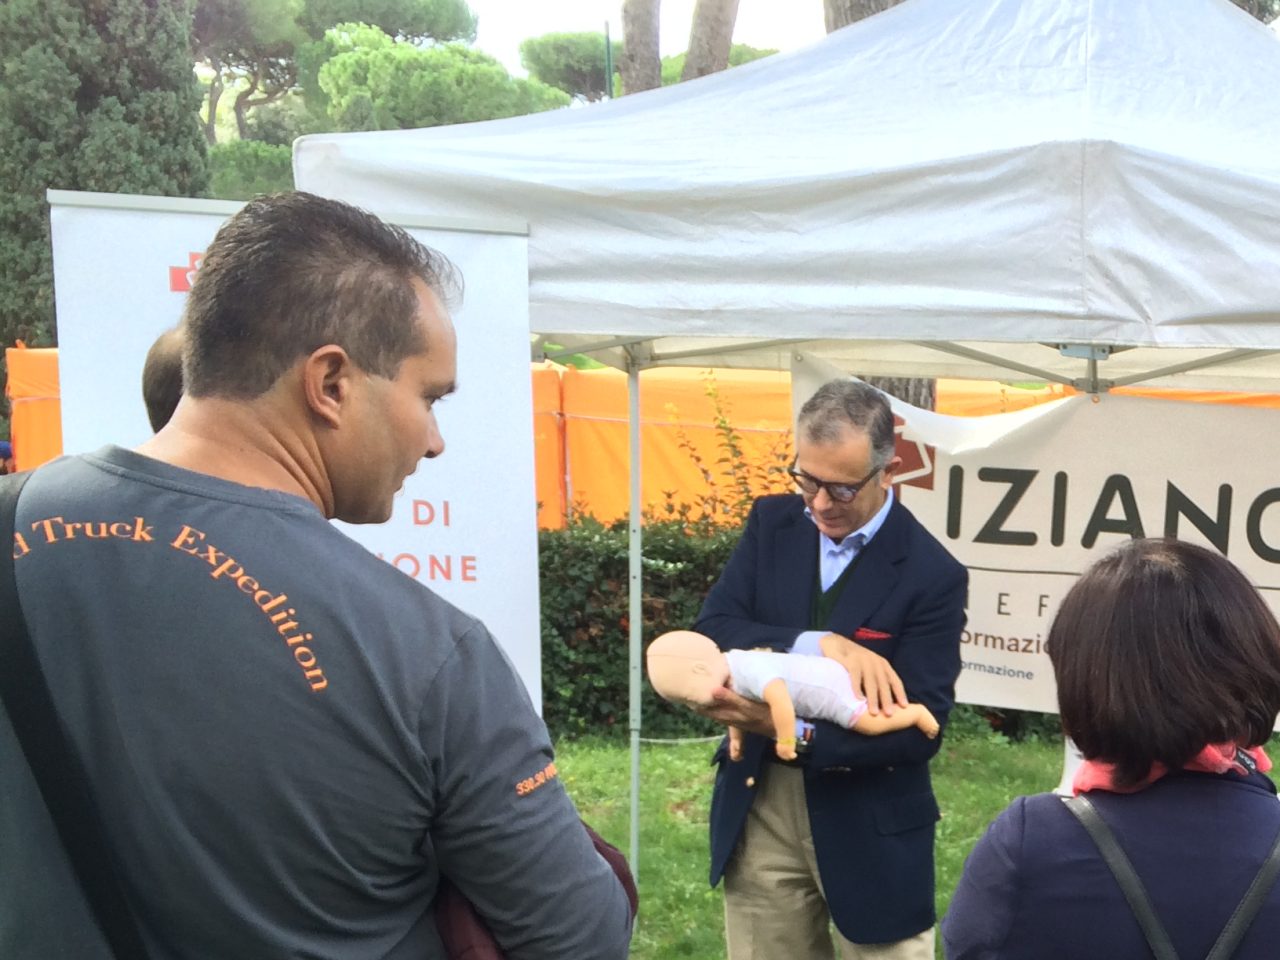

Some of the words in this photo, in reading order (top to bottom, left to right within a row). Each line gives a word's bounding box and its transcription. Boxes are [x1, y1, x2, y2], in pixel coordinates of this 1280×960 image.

[412, 499, 450, 527] DI
[377, 552, 477, 582] ONE
[31, 515, 155, 544] Truck
[170, 524, 329, 694] Expedition
